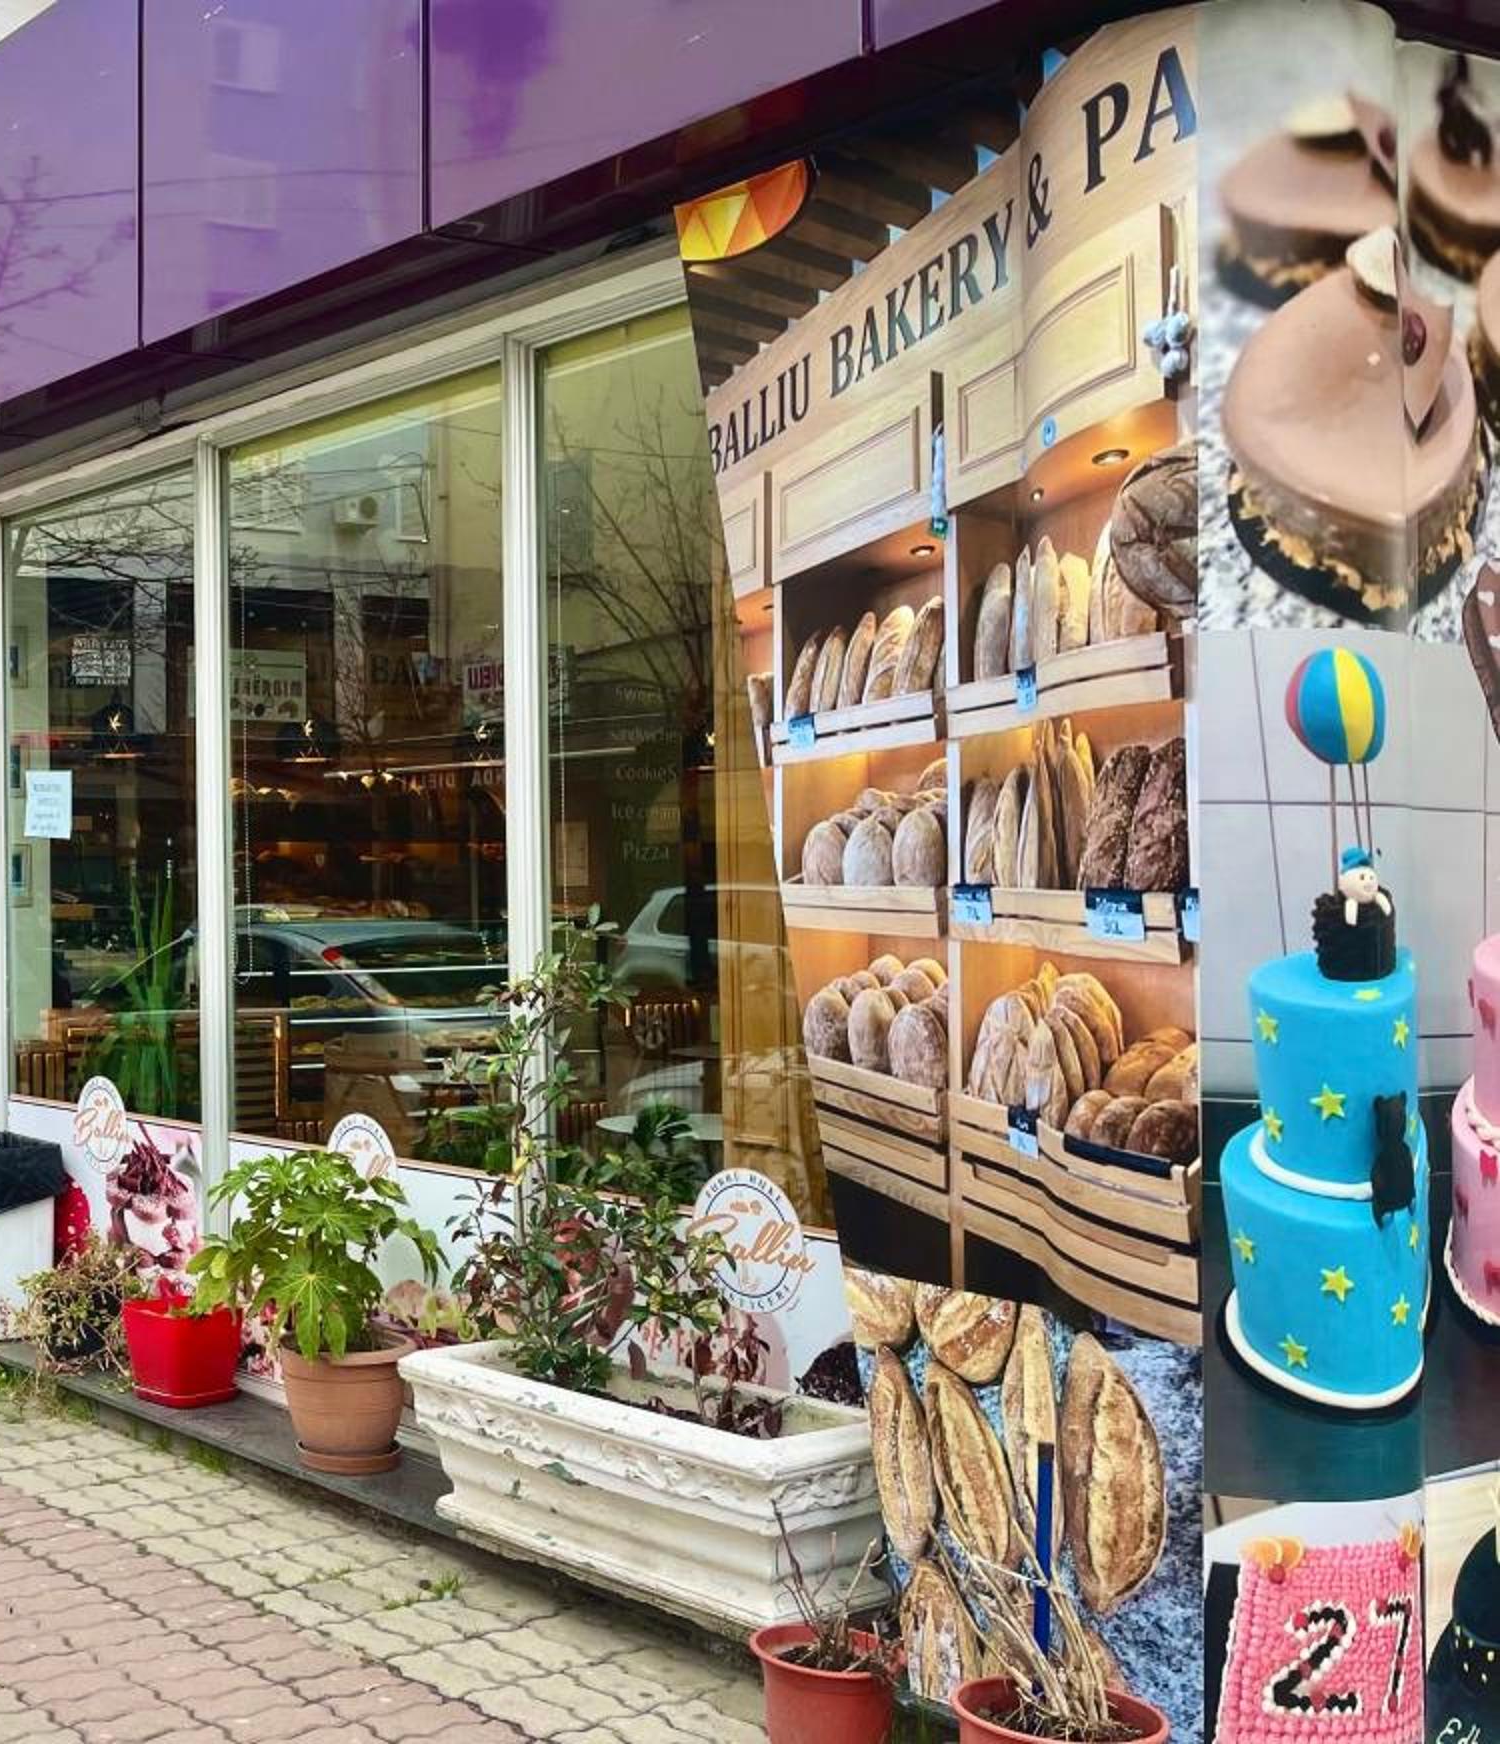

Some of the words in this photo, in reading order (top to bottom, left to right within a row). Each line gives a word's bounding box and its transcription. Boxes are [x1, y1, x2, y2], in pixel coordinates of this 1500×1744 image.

[708, 353, 811, 474] BALLIU
[829, 200, 1015, 399] BAKERY
[1026, 151, 1053, 249] &
[1082, 46, 1198, 194] PA
[1261, 1590, 1413, 1717] 27
